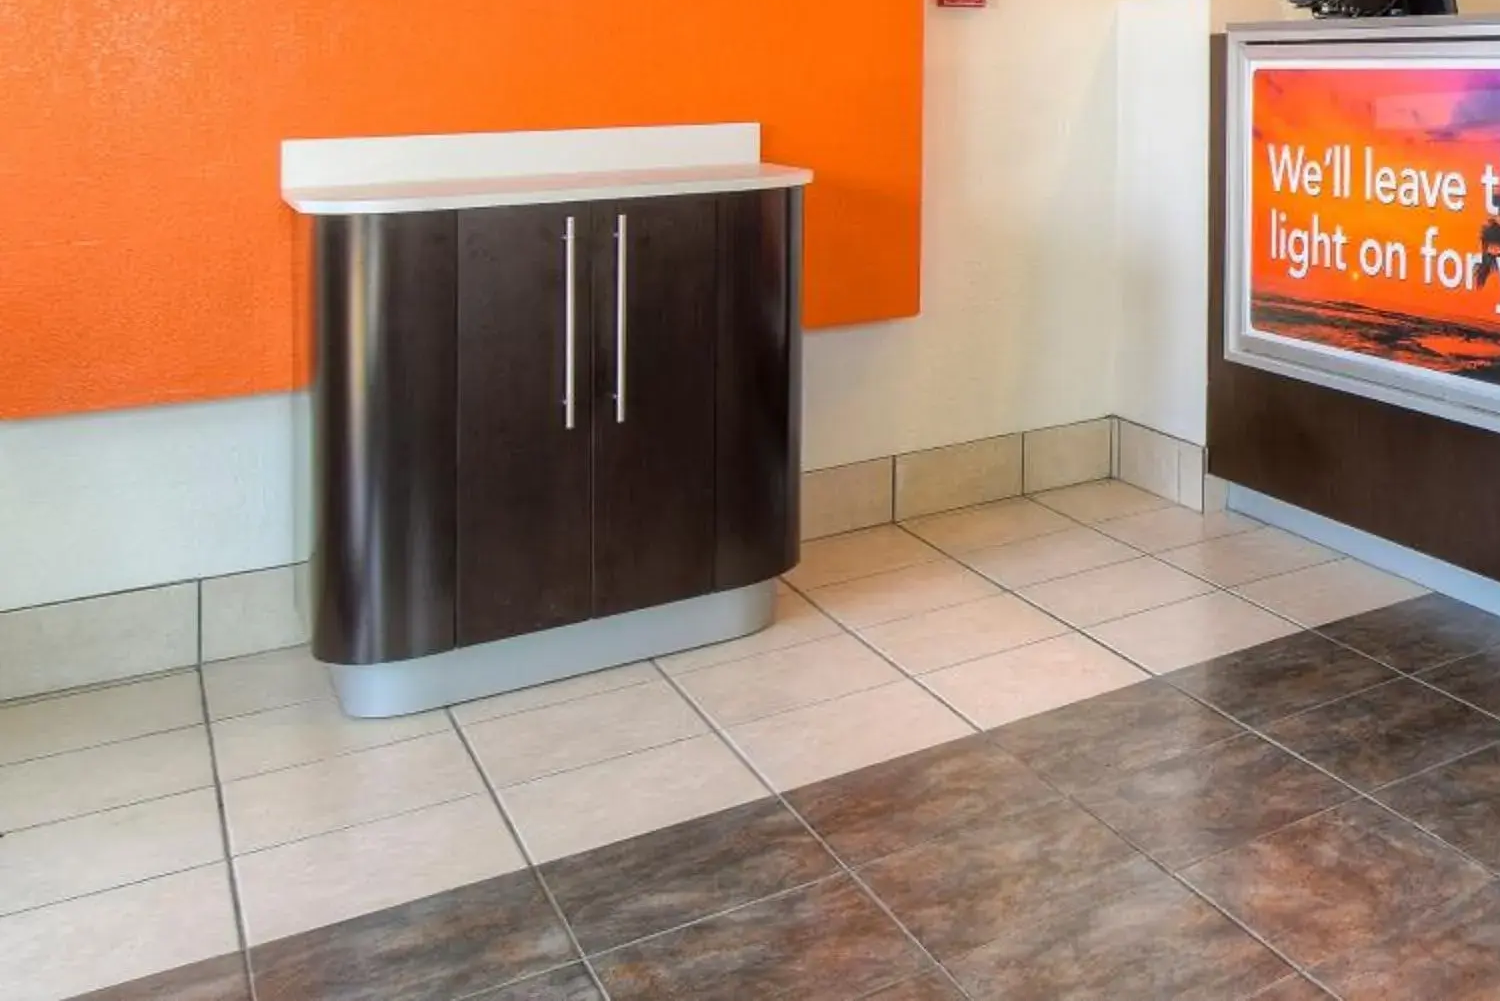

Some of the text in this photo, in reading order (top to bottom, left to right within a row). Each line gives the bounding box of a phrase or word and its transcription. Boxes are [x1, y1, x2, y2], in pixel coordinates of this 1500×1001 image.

[1268, 144, 1351, 198] We'll
[1365, 146, 1467, 211] leave
[1270, 208, 1347, 279] light
[1359, 238, 1407, 280] on
[1421, 225, 1483, 291] for
